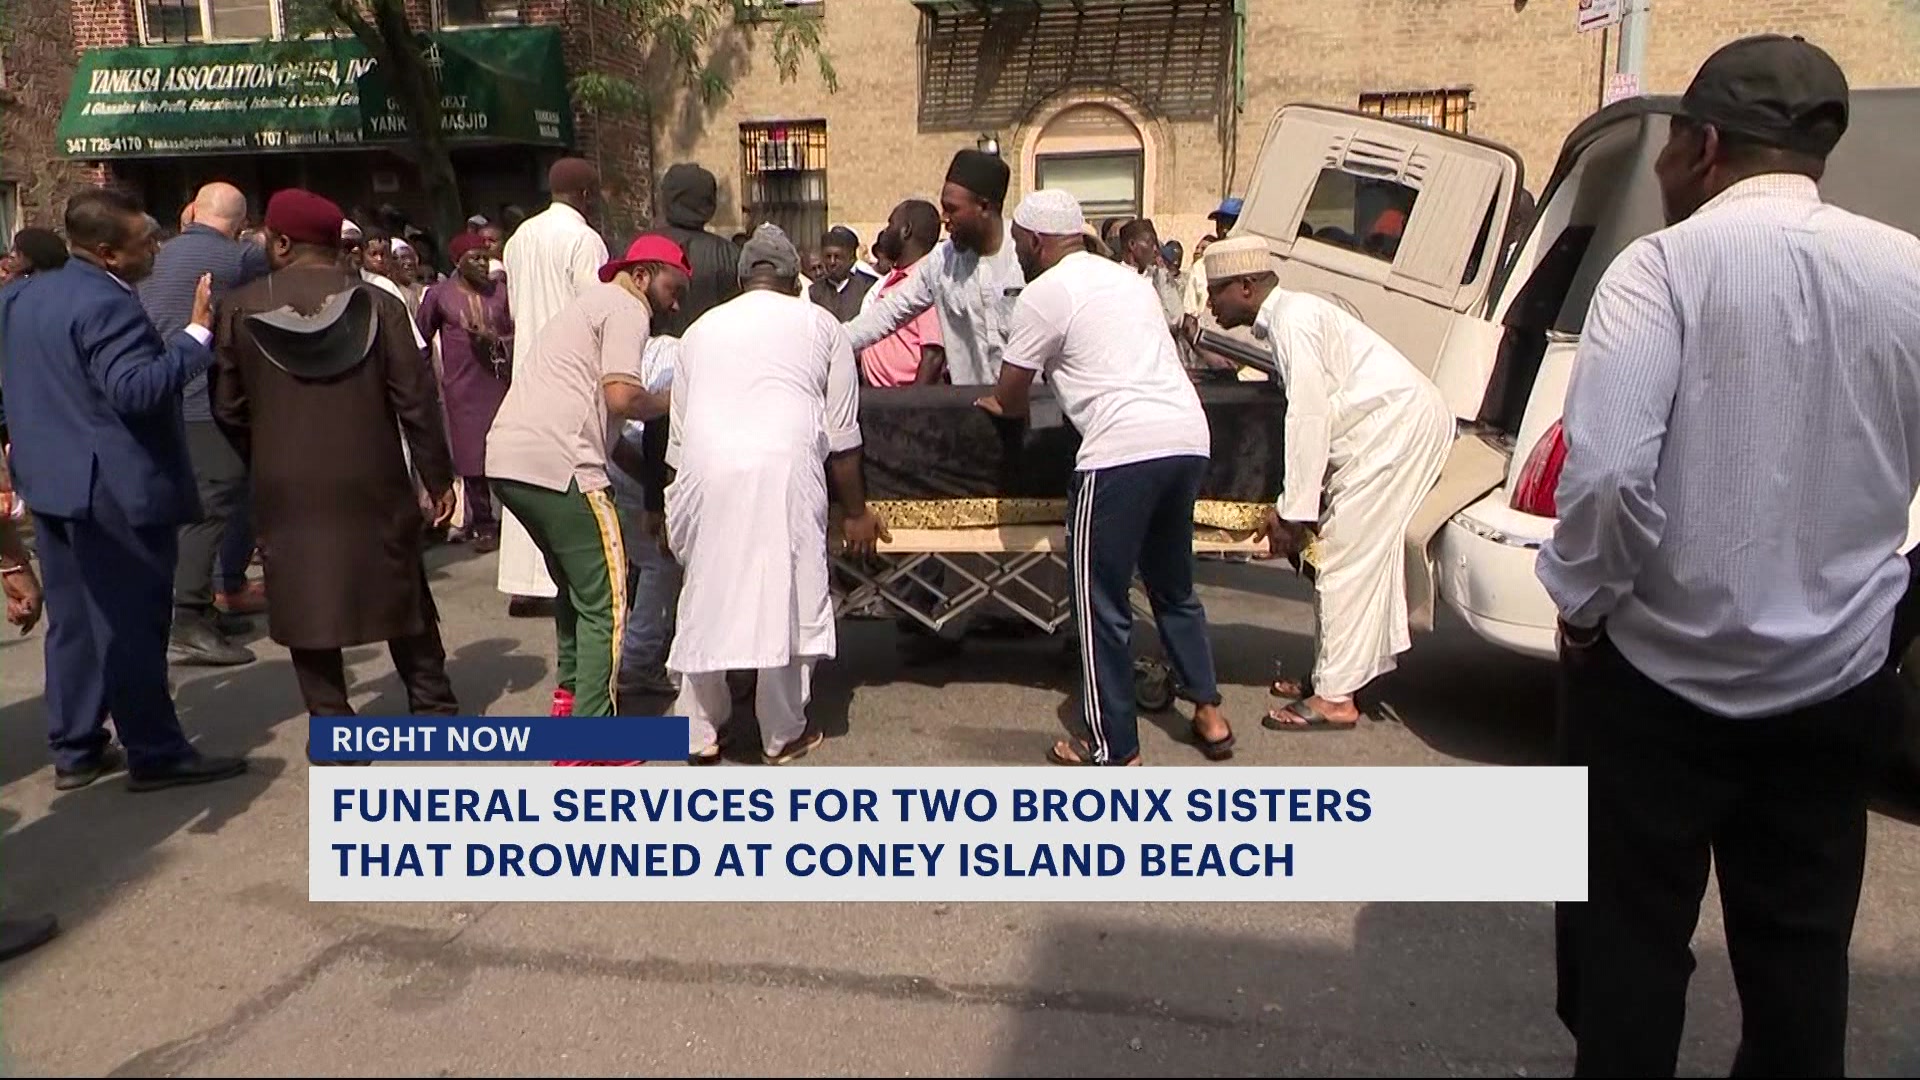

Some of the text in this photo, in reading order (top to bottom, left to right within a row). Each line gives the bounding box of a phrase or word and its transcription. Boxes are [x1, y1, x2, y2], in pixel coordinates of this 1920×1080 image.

[88, 67, 160, 94] YANKASA
[161, 63, 277, 91] ASSOCIATION
[370, 115, 408, 133] YANK
[253, 130, 283, 148] 1707
